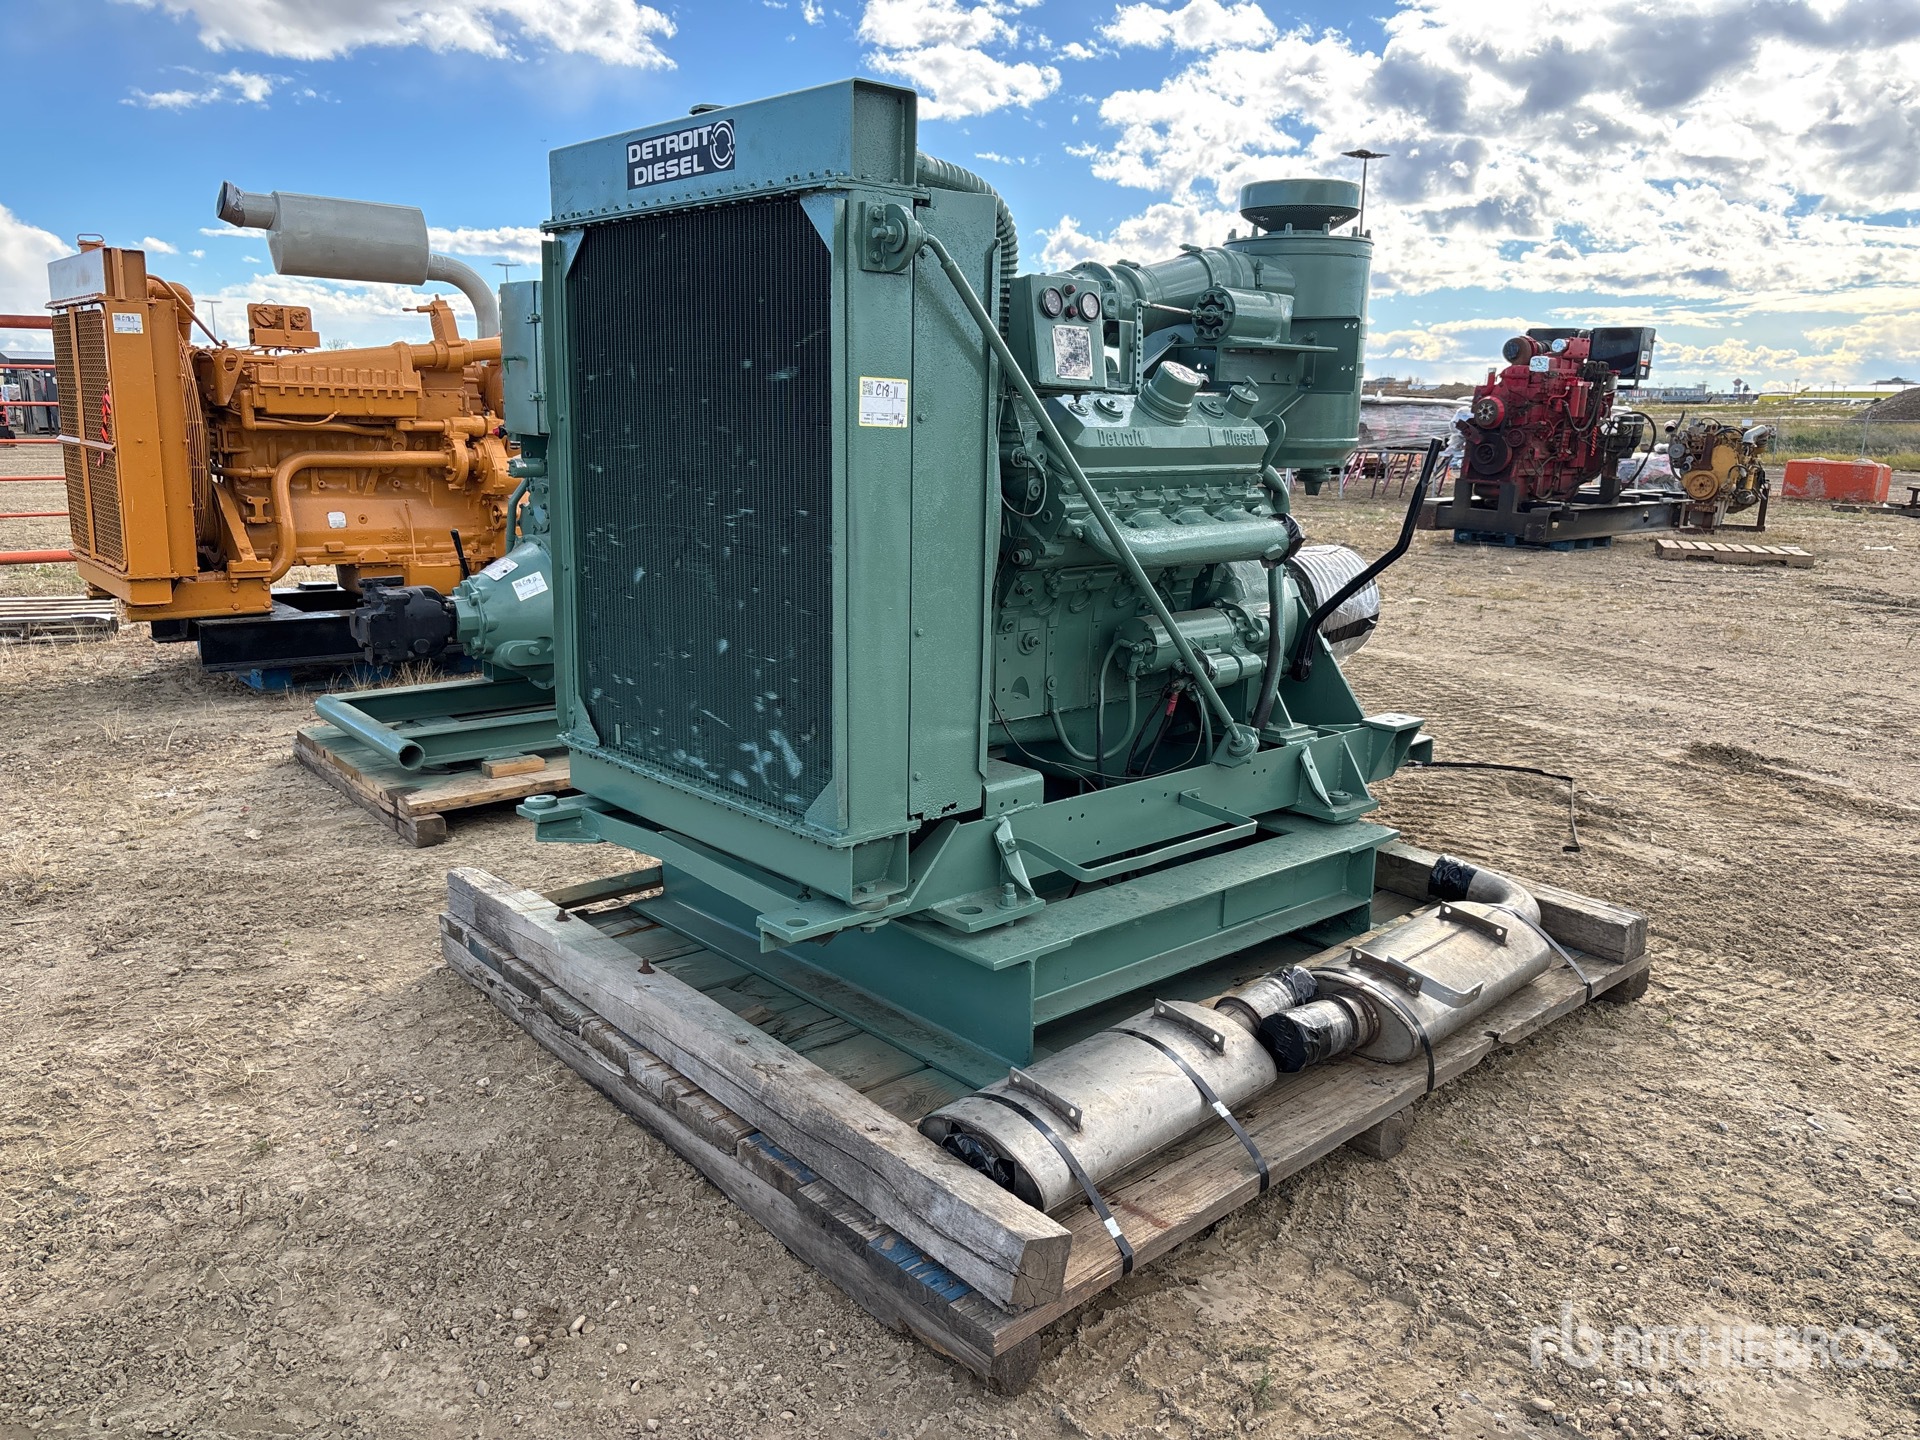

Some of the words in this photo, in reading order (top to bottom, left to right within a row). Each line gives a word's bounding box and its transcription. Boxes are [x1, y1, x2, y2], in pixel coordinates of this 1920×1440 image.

[628, 126, 712, 163] DETROIT
[634, 154, 704, 185] DIESEL
[1097, 428, 1145, 447] Detroit
[1223, 428, 1257, 446] Diesel
